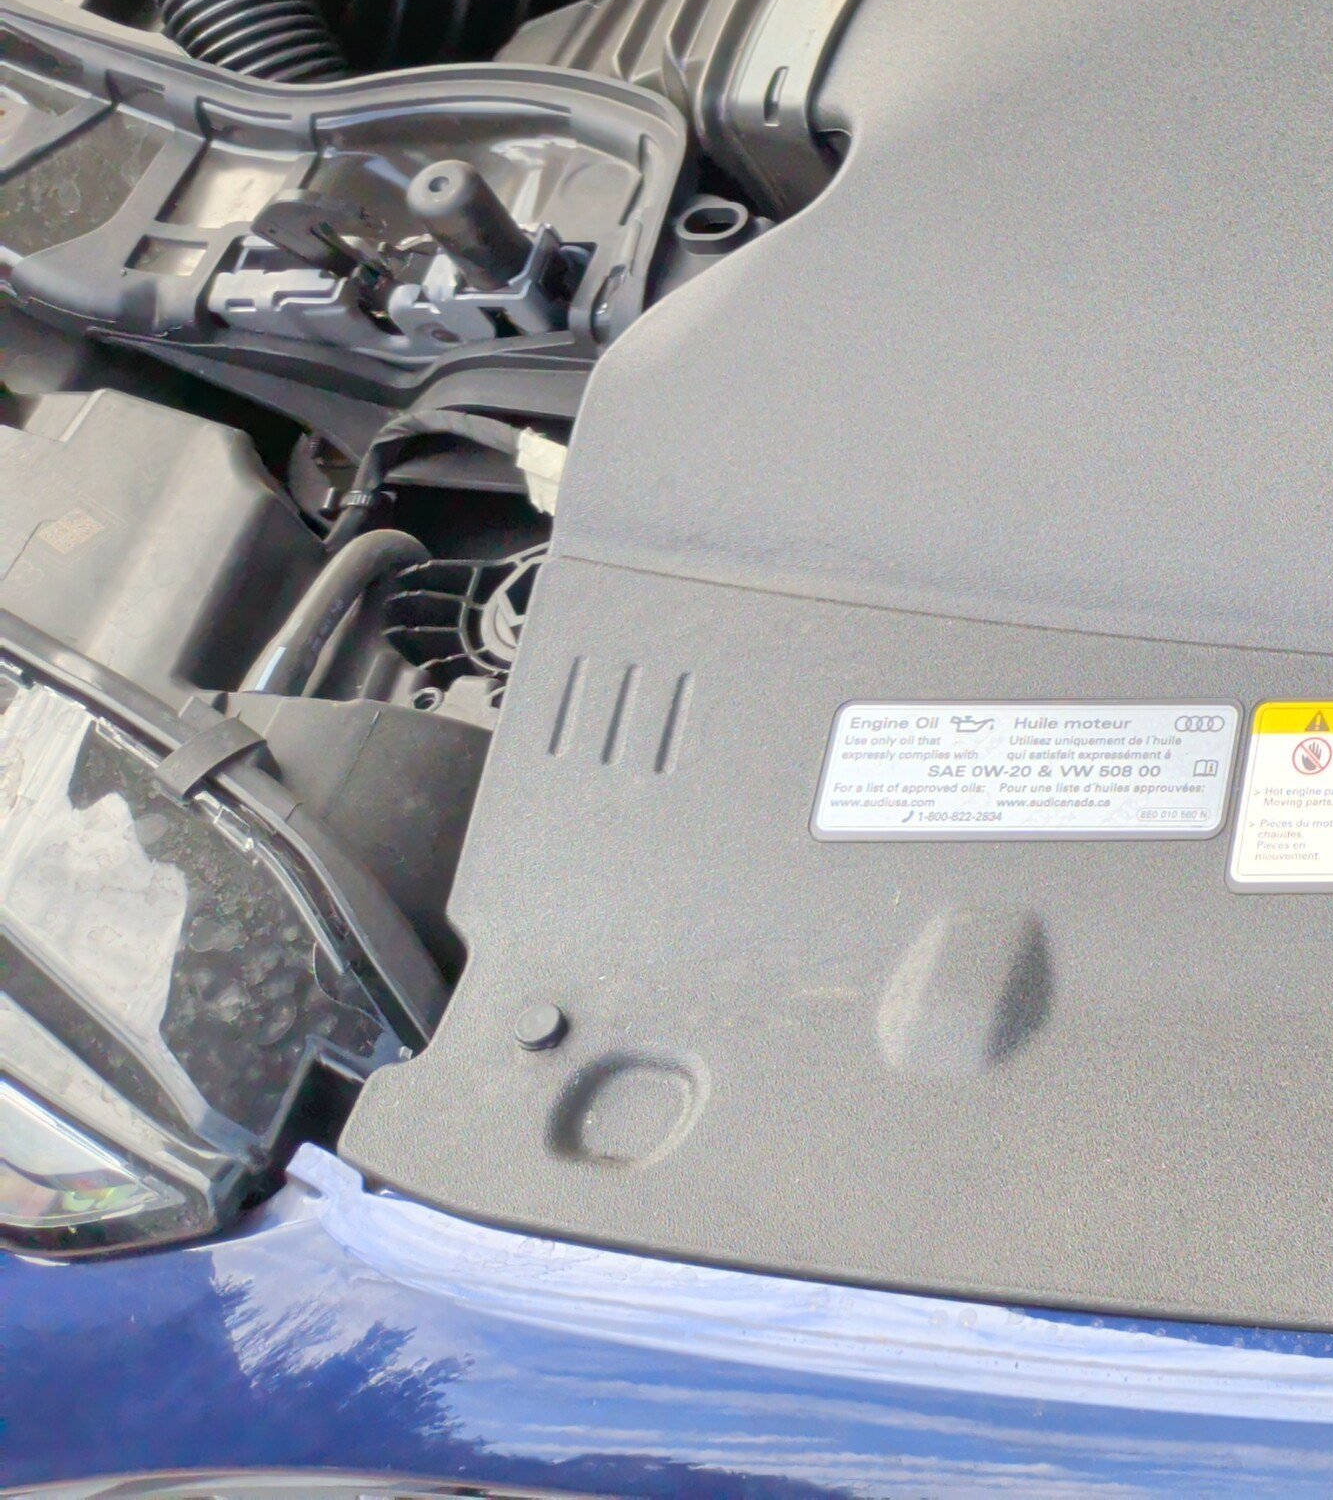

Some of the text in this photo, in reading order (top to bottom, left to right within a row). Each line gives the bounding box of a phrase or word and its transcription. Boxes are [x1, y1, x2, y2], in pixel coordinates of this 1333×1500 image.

[850, 717, 939, 731] Engine Oil
[1014, 717, 1131, 729] Huile moteur
[845, 736, 942, 748] Use only oil that
[1009, 736, 1051, 745] Utilisez
[1055, 736, 1125, 748] uniquement
[1129, 736, 1142, 745] de
[842, 750, 978, 762] expressly complies with
[1007, 750, 1026, 762] qui
[1029, 750, 1074, 759] satisfait
[1078, 750, 1161, 762] expressément
[928, 765, 1161, 777] SAE 0W-20 & VW 508 00
[834, 783, 853, 792] For
[867, 783, 884, 792] list
[887, 783, 900, 792] of
[902, 783, 958, 795] approved
[961, 783, 986, 793] oils:
[1000, 782, 1206, 795] Pour une liste d'huiles approuvées:
[1286, 787, 1321, 797] engine
[831, 798, 935, 807] www.audiusa.com
[998, 799, 1110, 807] www.audicanada.ca
[1264, 798, 1302, 808] Moving
[918, 812, 1002, 821] 1-800-822-2834
[1296, 818, 1310, 827] du
